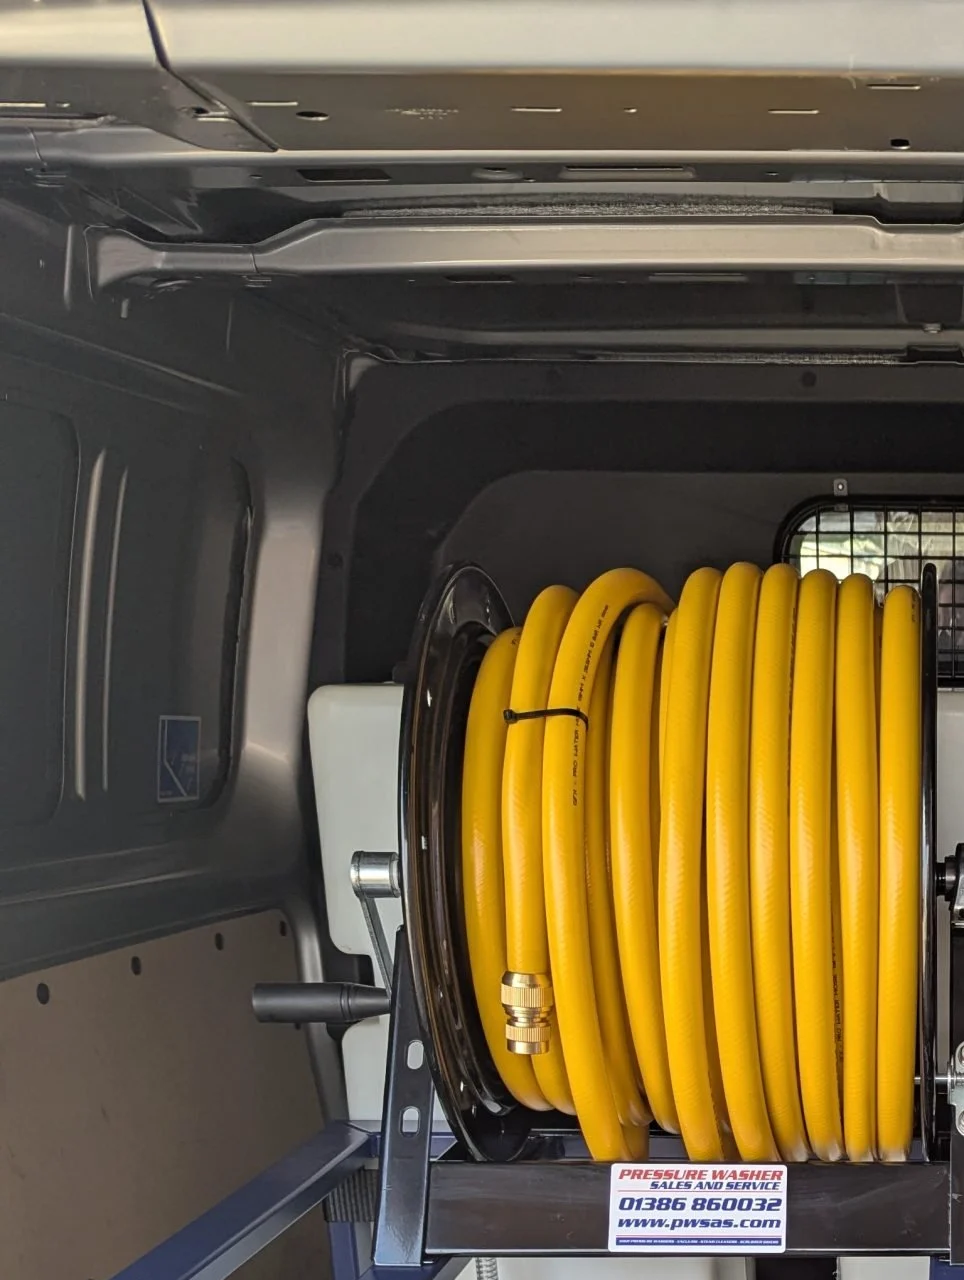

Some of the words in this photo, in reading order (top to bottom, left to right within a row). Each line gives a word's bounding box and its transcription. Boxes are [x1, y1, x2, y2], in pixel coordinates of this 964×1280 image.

[618, 1169, 709, 1181] PRESSURE
[711, 1169, 784, 1181] WASHER
[649, 1181, 692, 1190] SALES
[693, 1181, 725, 1190] AND
[726, 1181, 782, 1191] SERVICE
[618, 1197, 687, 1211] 01386
[691, 1197, 783, 1212] 860032
[618, 1218, 782, 1231] www.pwsas.com
